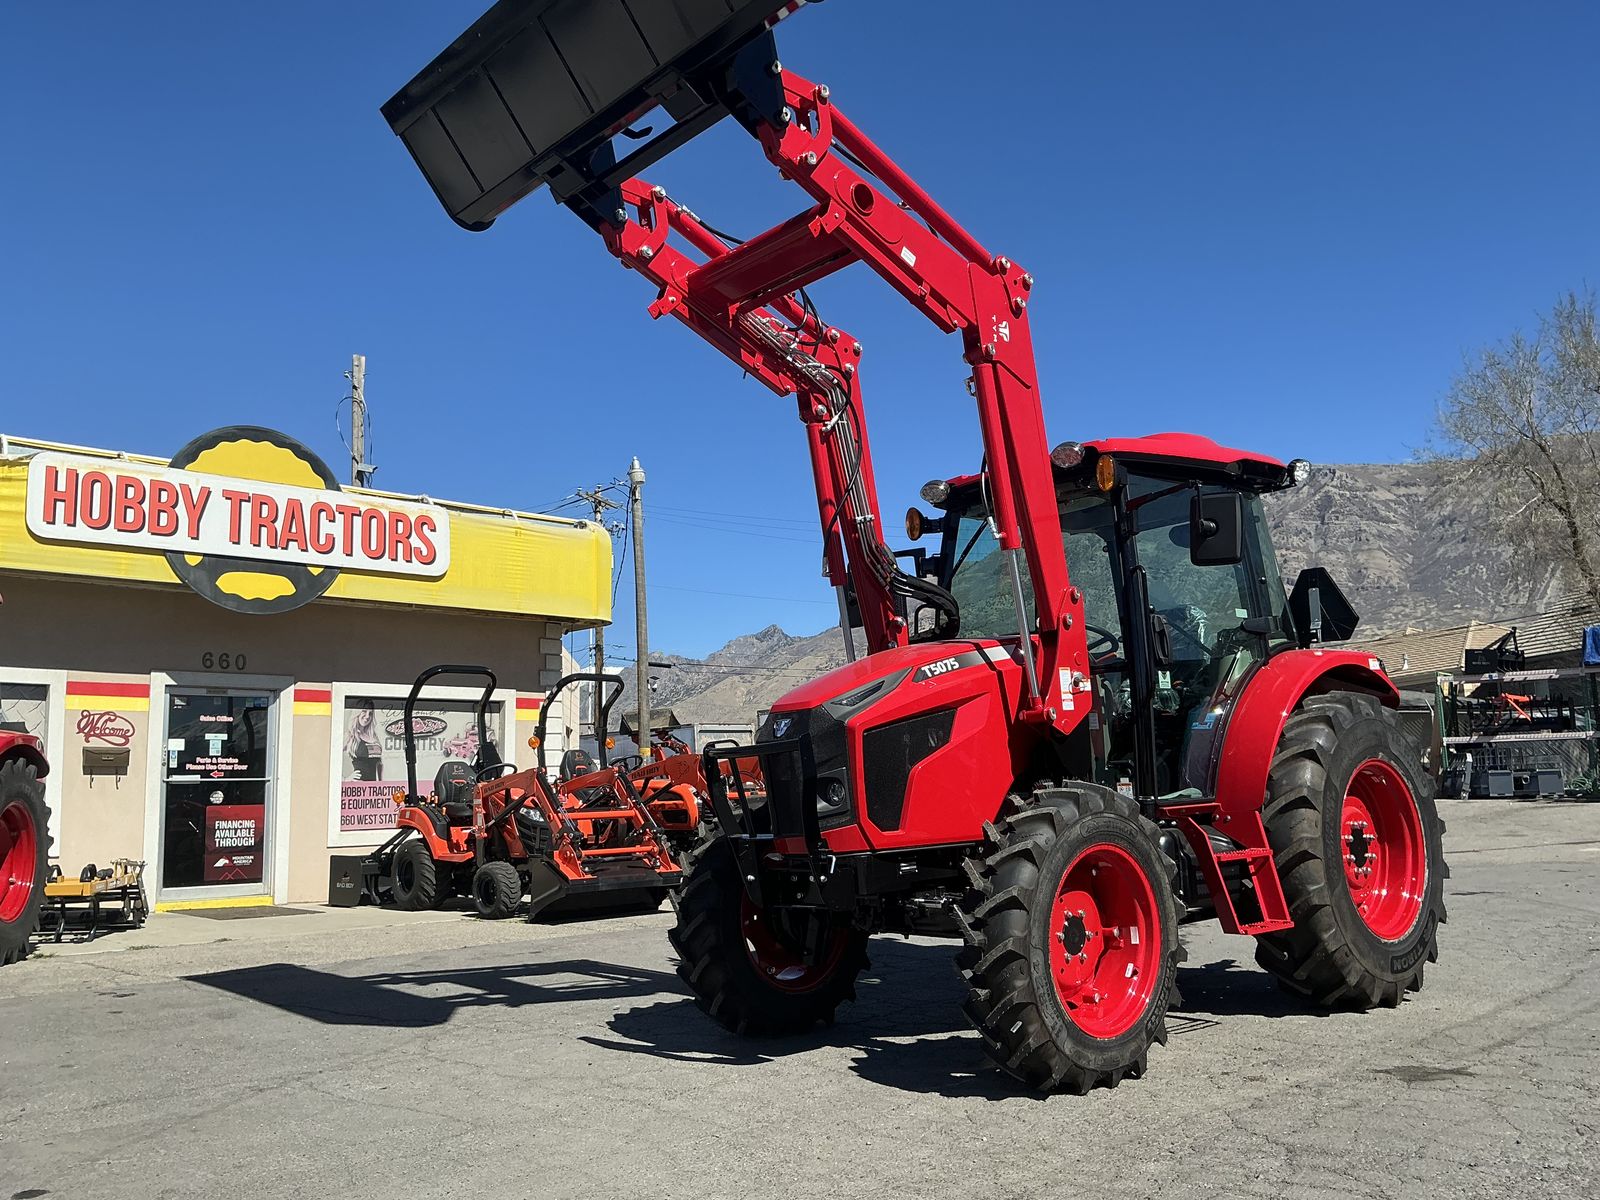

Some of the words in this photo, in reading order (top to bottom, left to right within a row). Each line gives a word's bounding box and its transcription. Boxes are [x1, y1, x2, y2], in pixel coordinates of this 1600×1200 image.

[43, 465, 211, 540] HOBBY
[222, 489, 437, 565] TRACTORS
[202, 651, 247, 671] 660
[921, 657, 959, 677] T5075
[76, 709, 135, 746] Welcome
[384, 737, 446, 751] CONTRY
[341, 786, 367, 797] HOBBY
[341, 799, 347, 809] &
[348, 798, 391, 810] EQUIPMENT
[215, 820, 255, 829] FINANCING
[341, 815, 355, 825] 660
[357, 814, 378, 825] WEST
[379, 813, 399, 824] STAT
[215, 829, 255, 838] AVAILABLE
[215, 838, 255, 847] THROUGH
